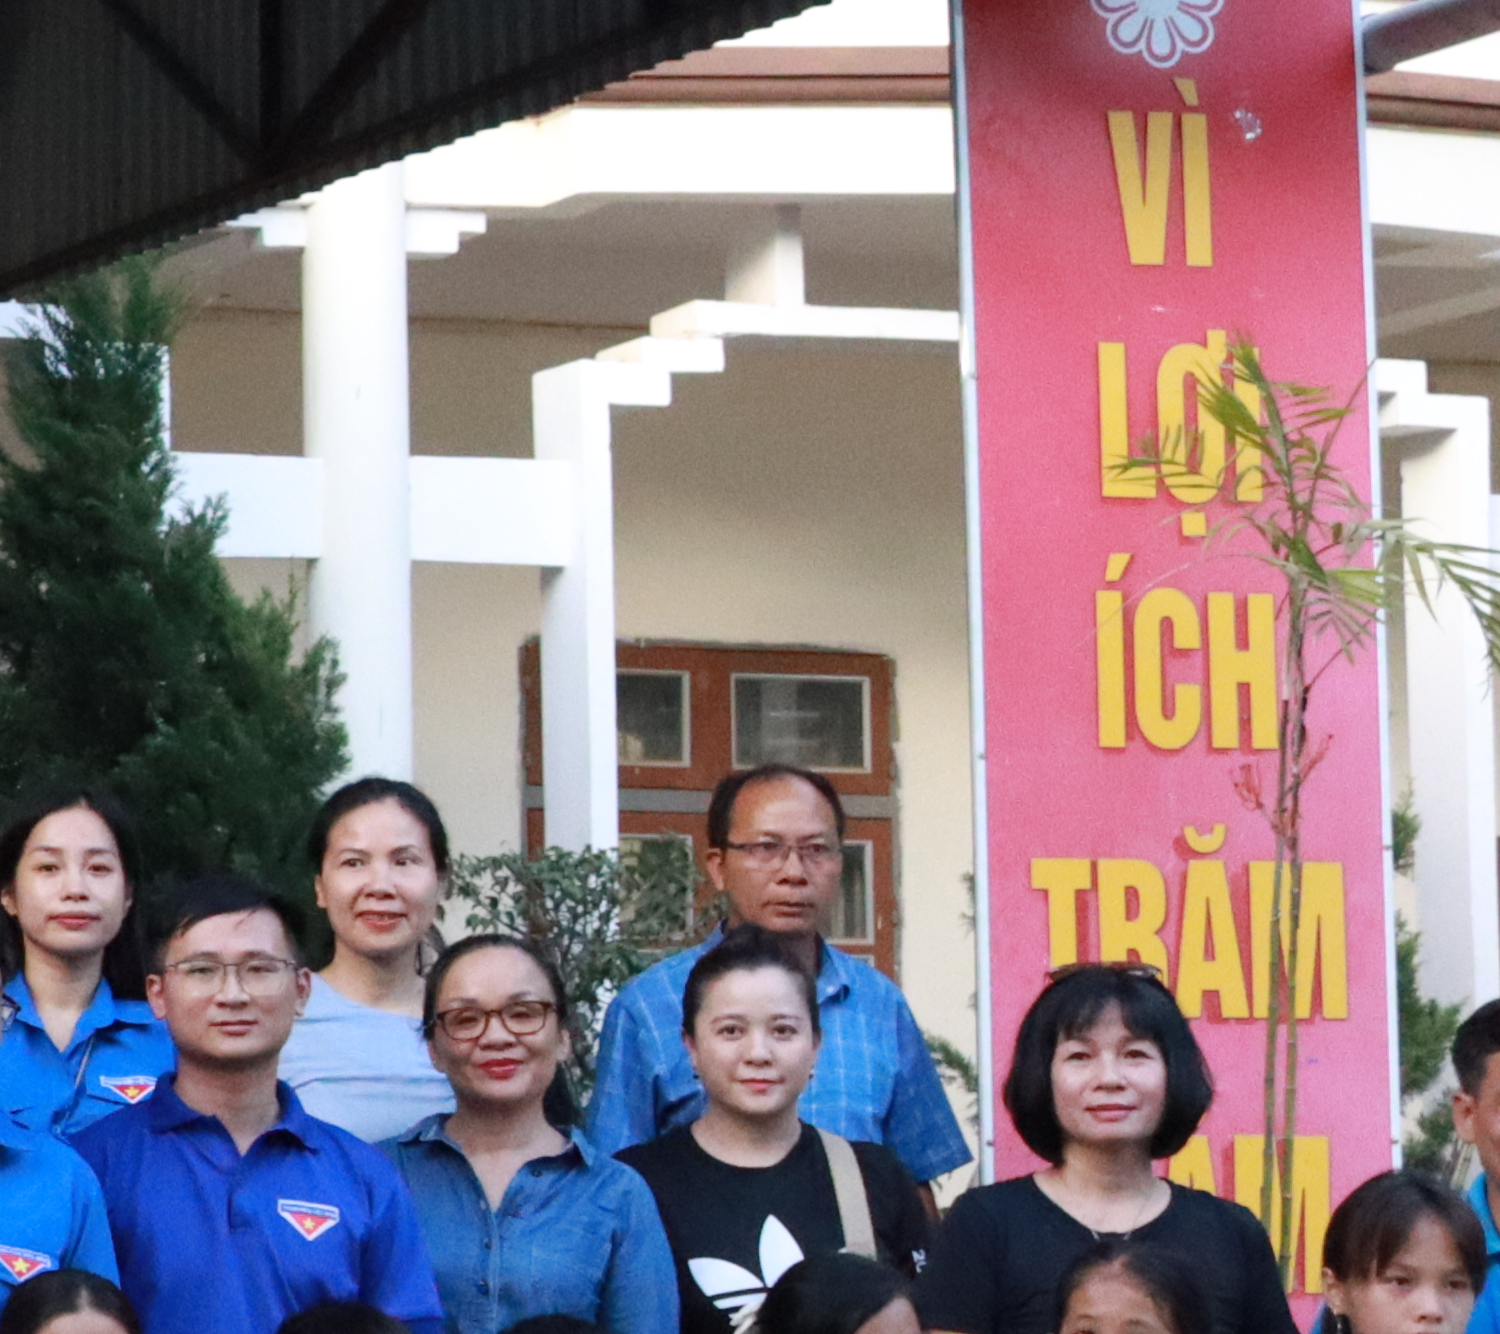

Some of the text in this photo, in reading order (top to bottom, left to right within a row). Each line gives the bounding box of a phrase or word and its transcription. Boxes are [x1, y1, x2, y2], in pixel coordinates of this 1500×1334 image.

[1106, 77, 1216, 269] VÌ
[1096, 327, 1268, 539] LỢI
[1094, 551, 1280, 754] ÍCH
[1030, 823, 1349, 1020] TRĂM
